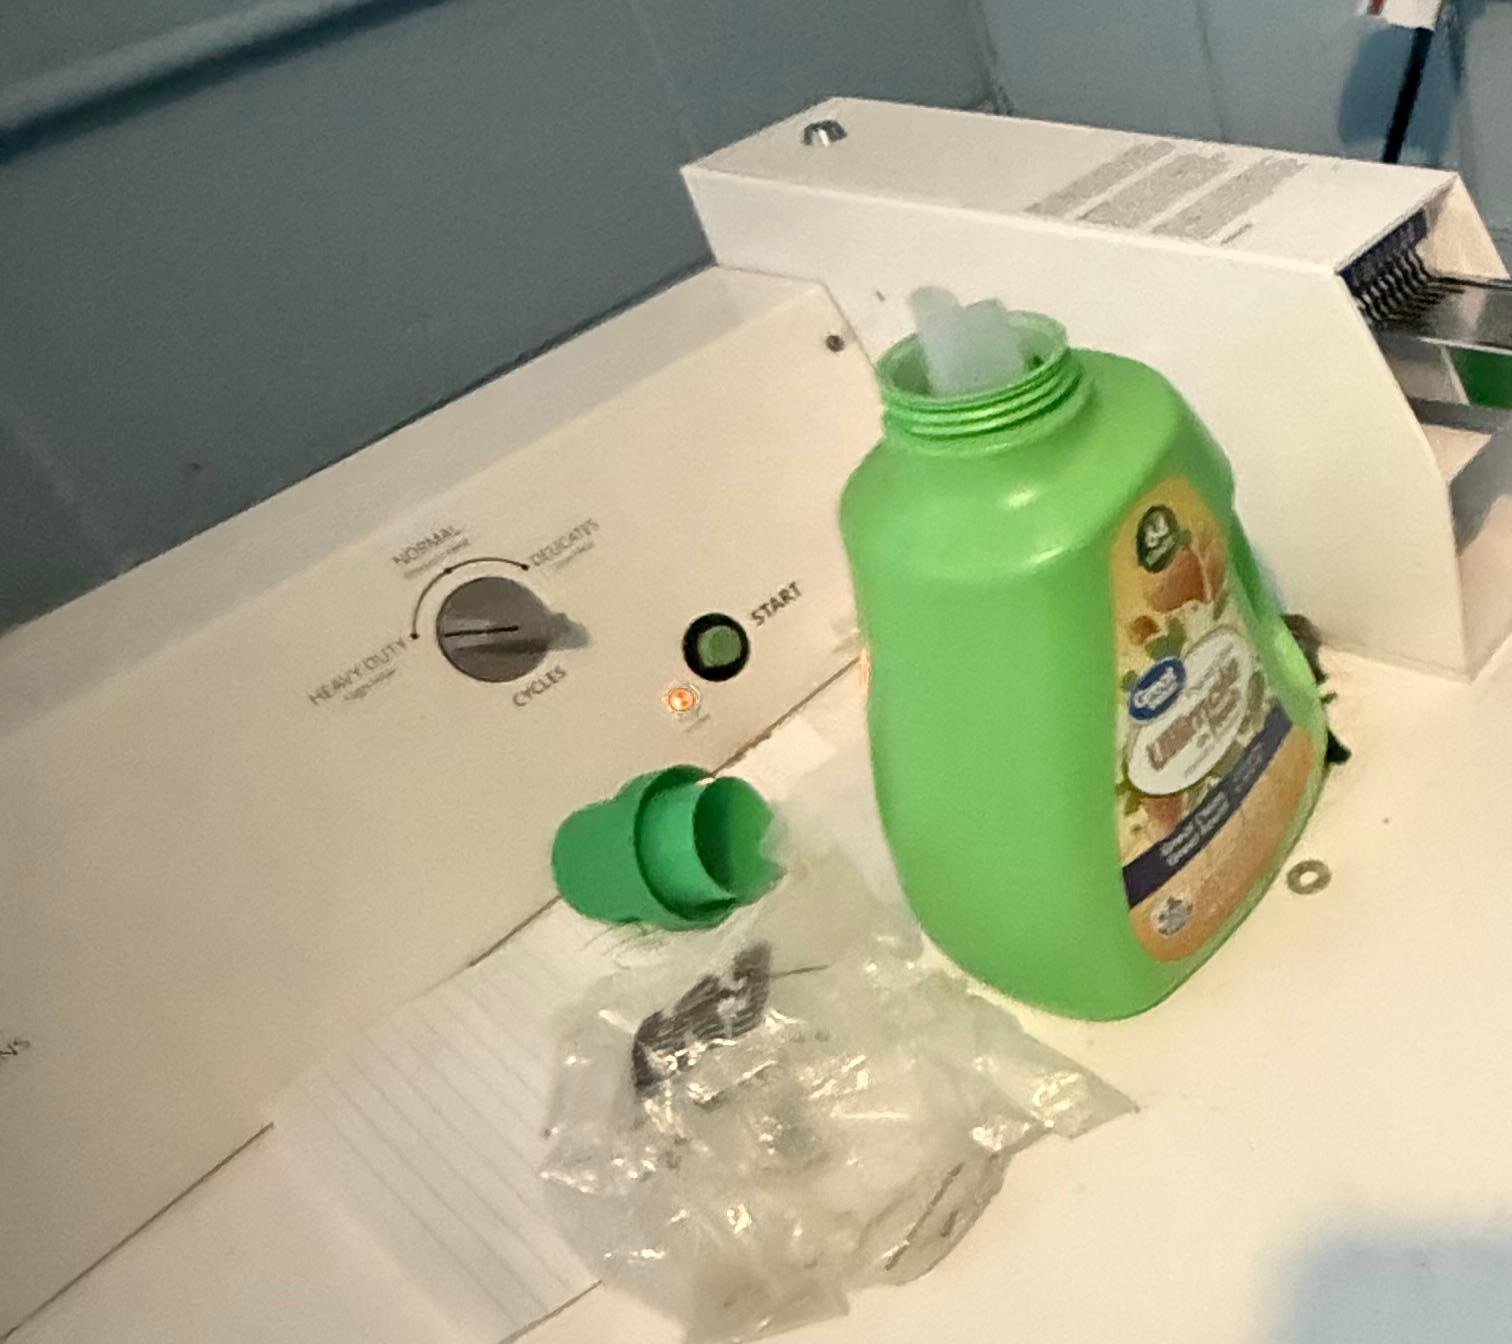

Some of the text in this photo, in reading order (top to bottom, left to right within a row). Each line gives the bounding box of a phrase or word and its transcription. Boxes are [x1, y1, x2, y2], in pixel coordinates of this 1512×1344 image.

[393, 525, 464, 565] NORMAL
[530, 518, 600, 566] DELICATES
[751, 581, 801, 627] START
[308, 663, 362, 705] HEAVY
[362, 638, 407, 671] DUTY
[511, 665, 567, 707] CYCLES
